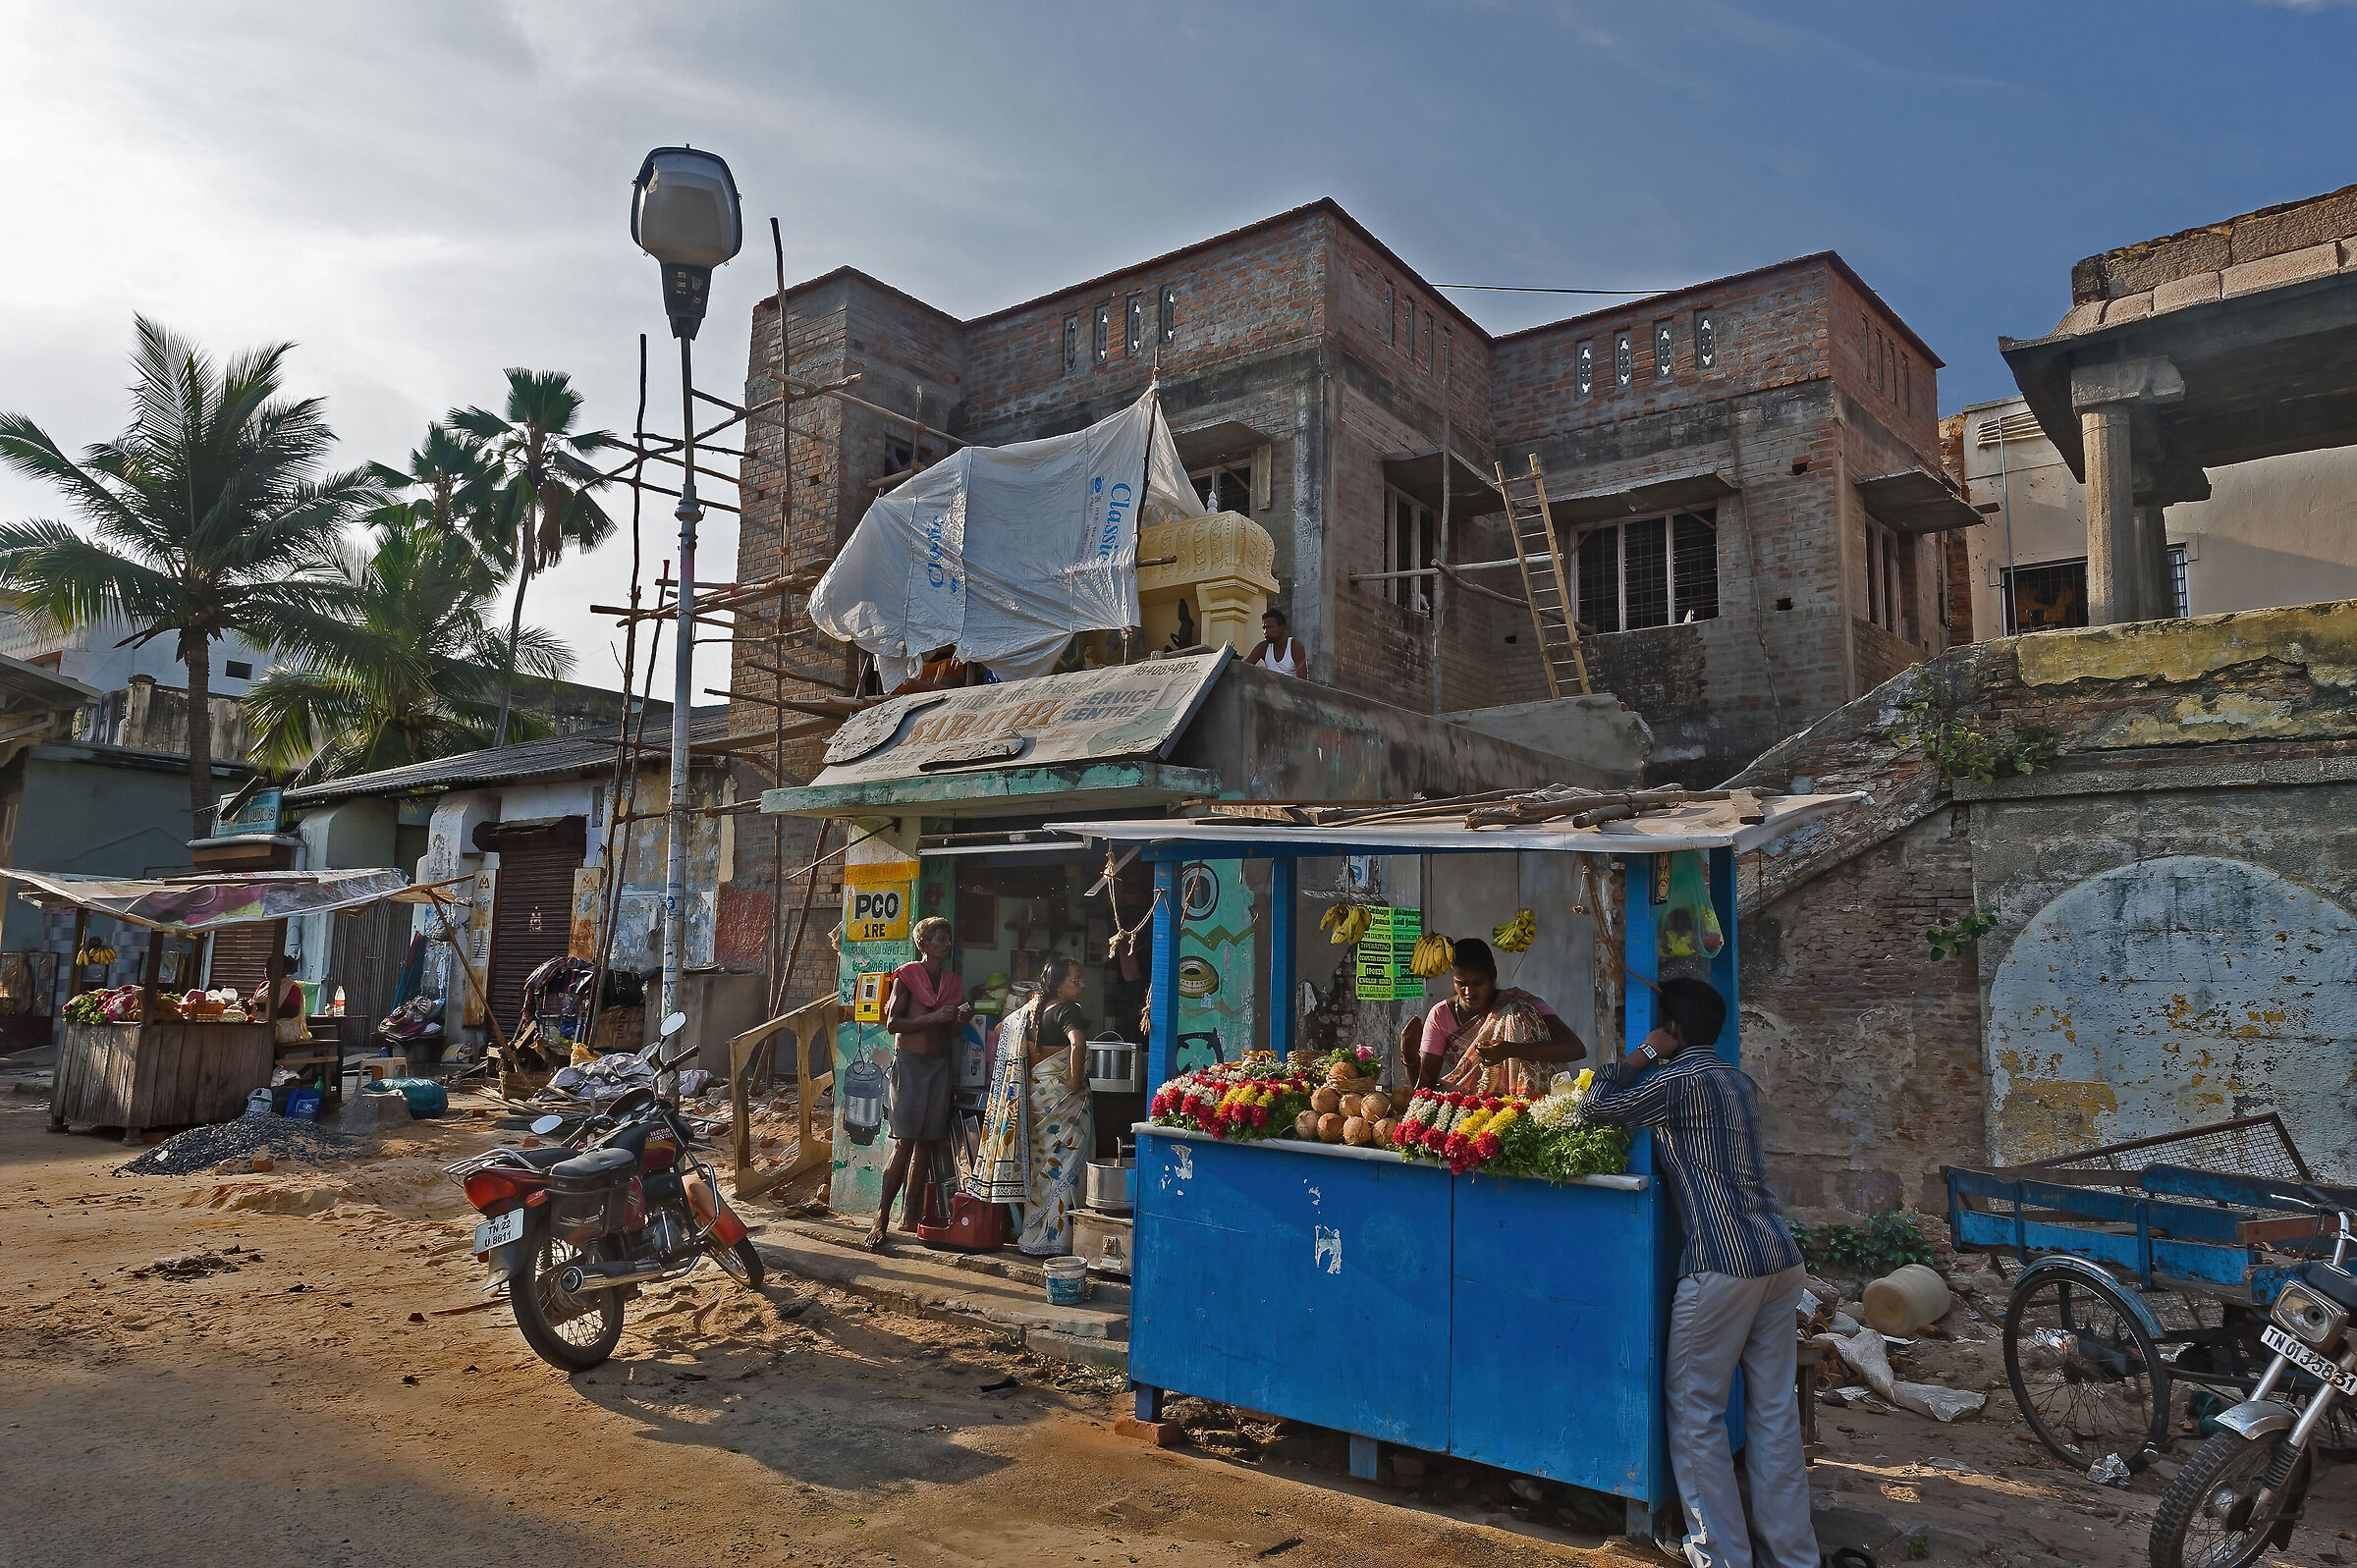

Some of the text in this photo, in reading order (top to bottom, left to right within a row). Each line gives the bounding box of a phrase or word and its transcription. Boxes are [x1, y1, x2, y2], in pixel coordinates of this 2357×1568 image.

[1074, 688, 1161, 706] SERVICE
[1061, 704, 1143, 722] CENTRE
[900, 700, 1069, 746] SARATHY
[855, 892, 899, 920] PCO
[648, 1132, 674, 1143] HONDA
[649, 1127, 671, 1137] HERO
[488, 1219, 511, 1234] TN 22
[2267, 1327, 2286, 1351] TN
[2284, 1340, 2303, 1360] 01
